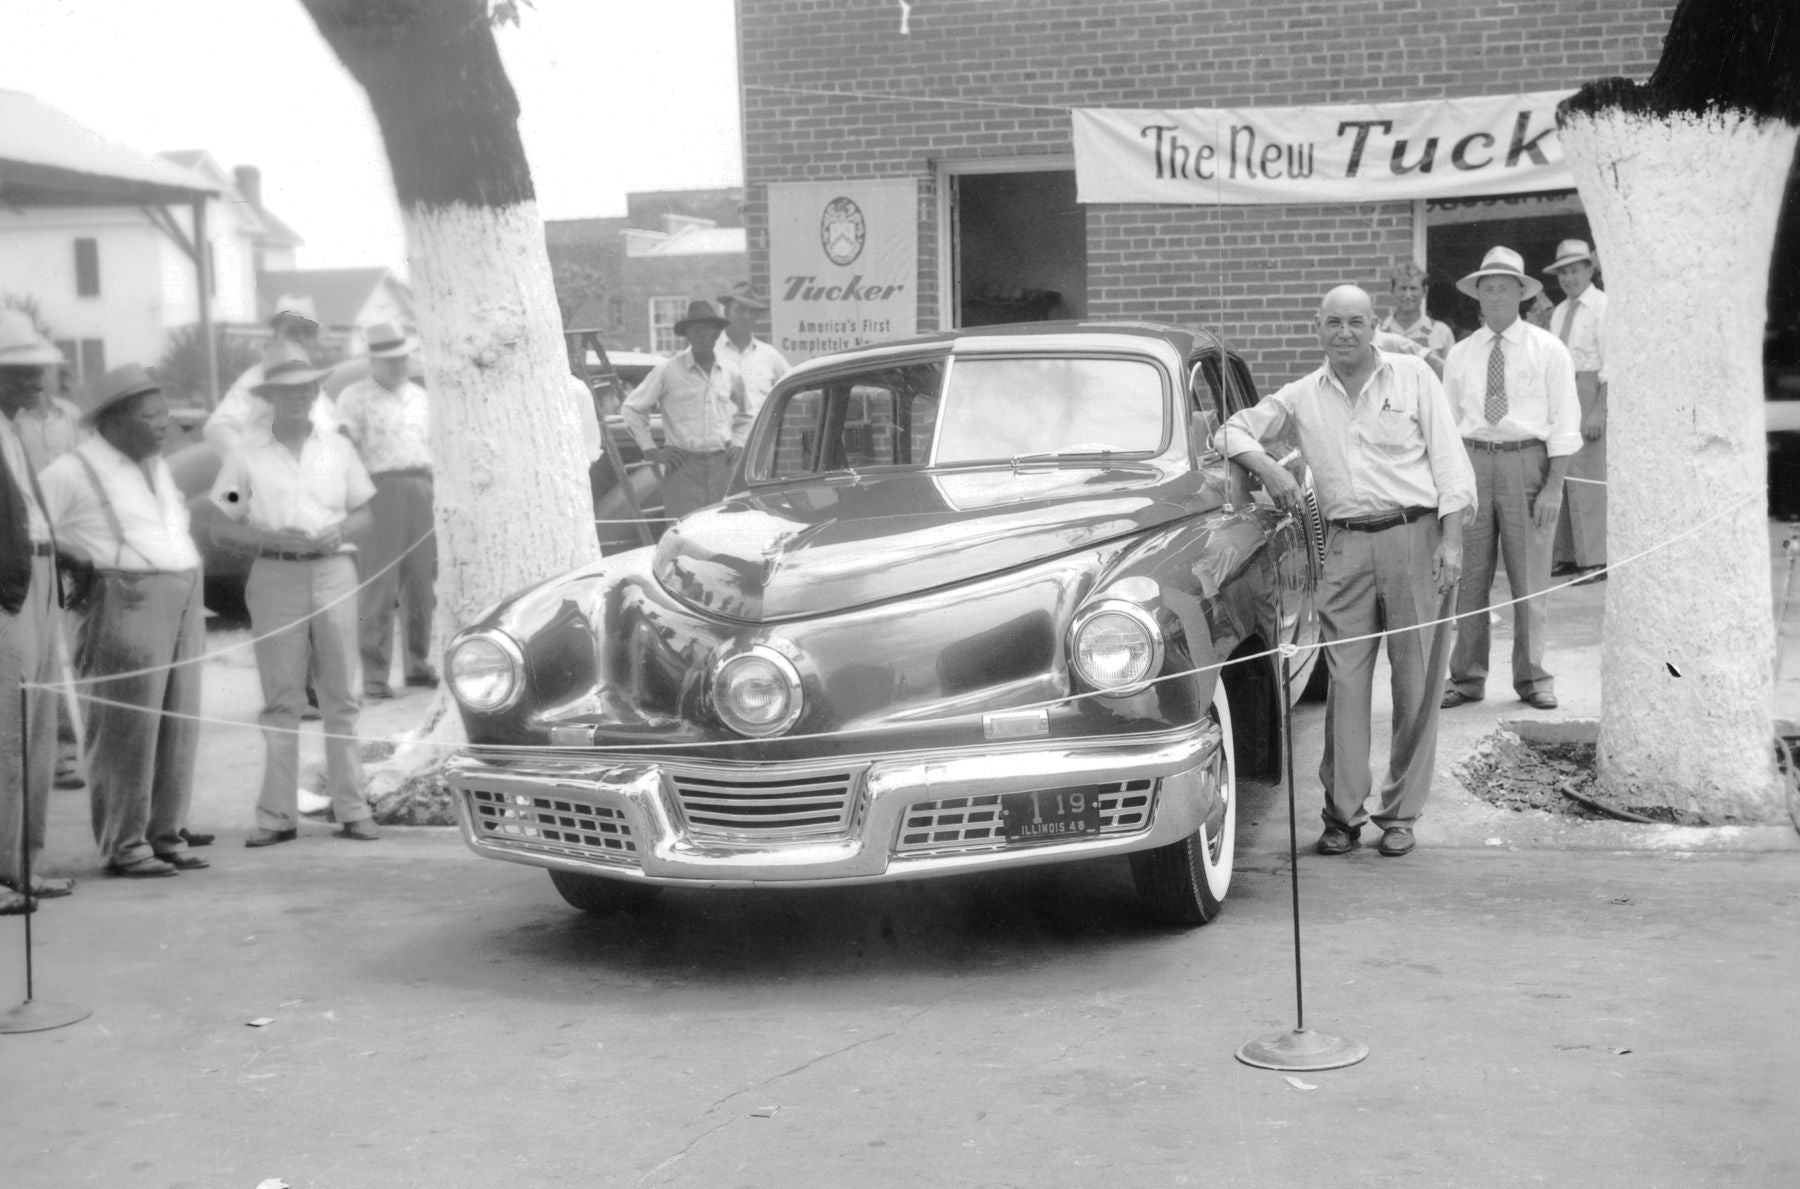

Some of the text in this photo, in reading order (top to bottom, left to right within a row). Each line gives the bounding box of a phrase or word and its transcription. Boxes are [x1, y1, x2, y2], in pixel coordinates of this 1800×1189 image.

[1140, 110, 1557, 180] The New Tuck
[783, 275, 904, 301] Tucker
[799, 319, 890, 333] America's First
[782, 337, 849, 352] Completely
[1021, 820, 1085, 835] ILLINOIS 48
